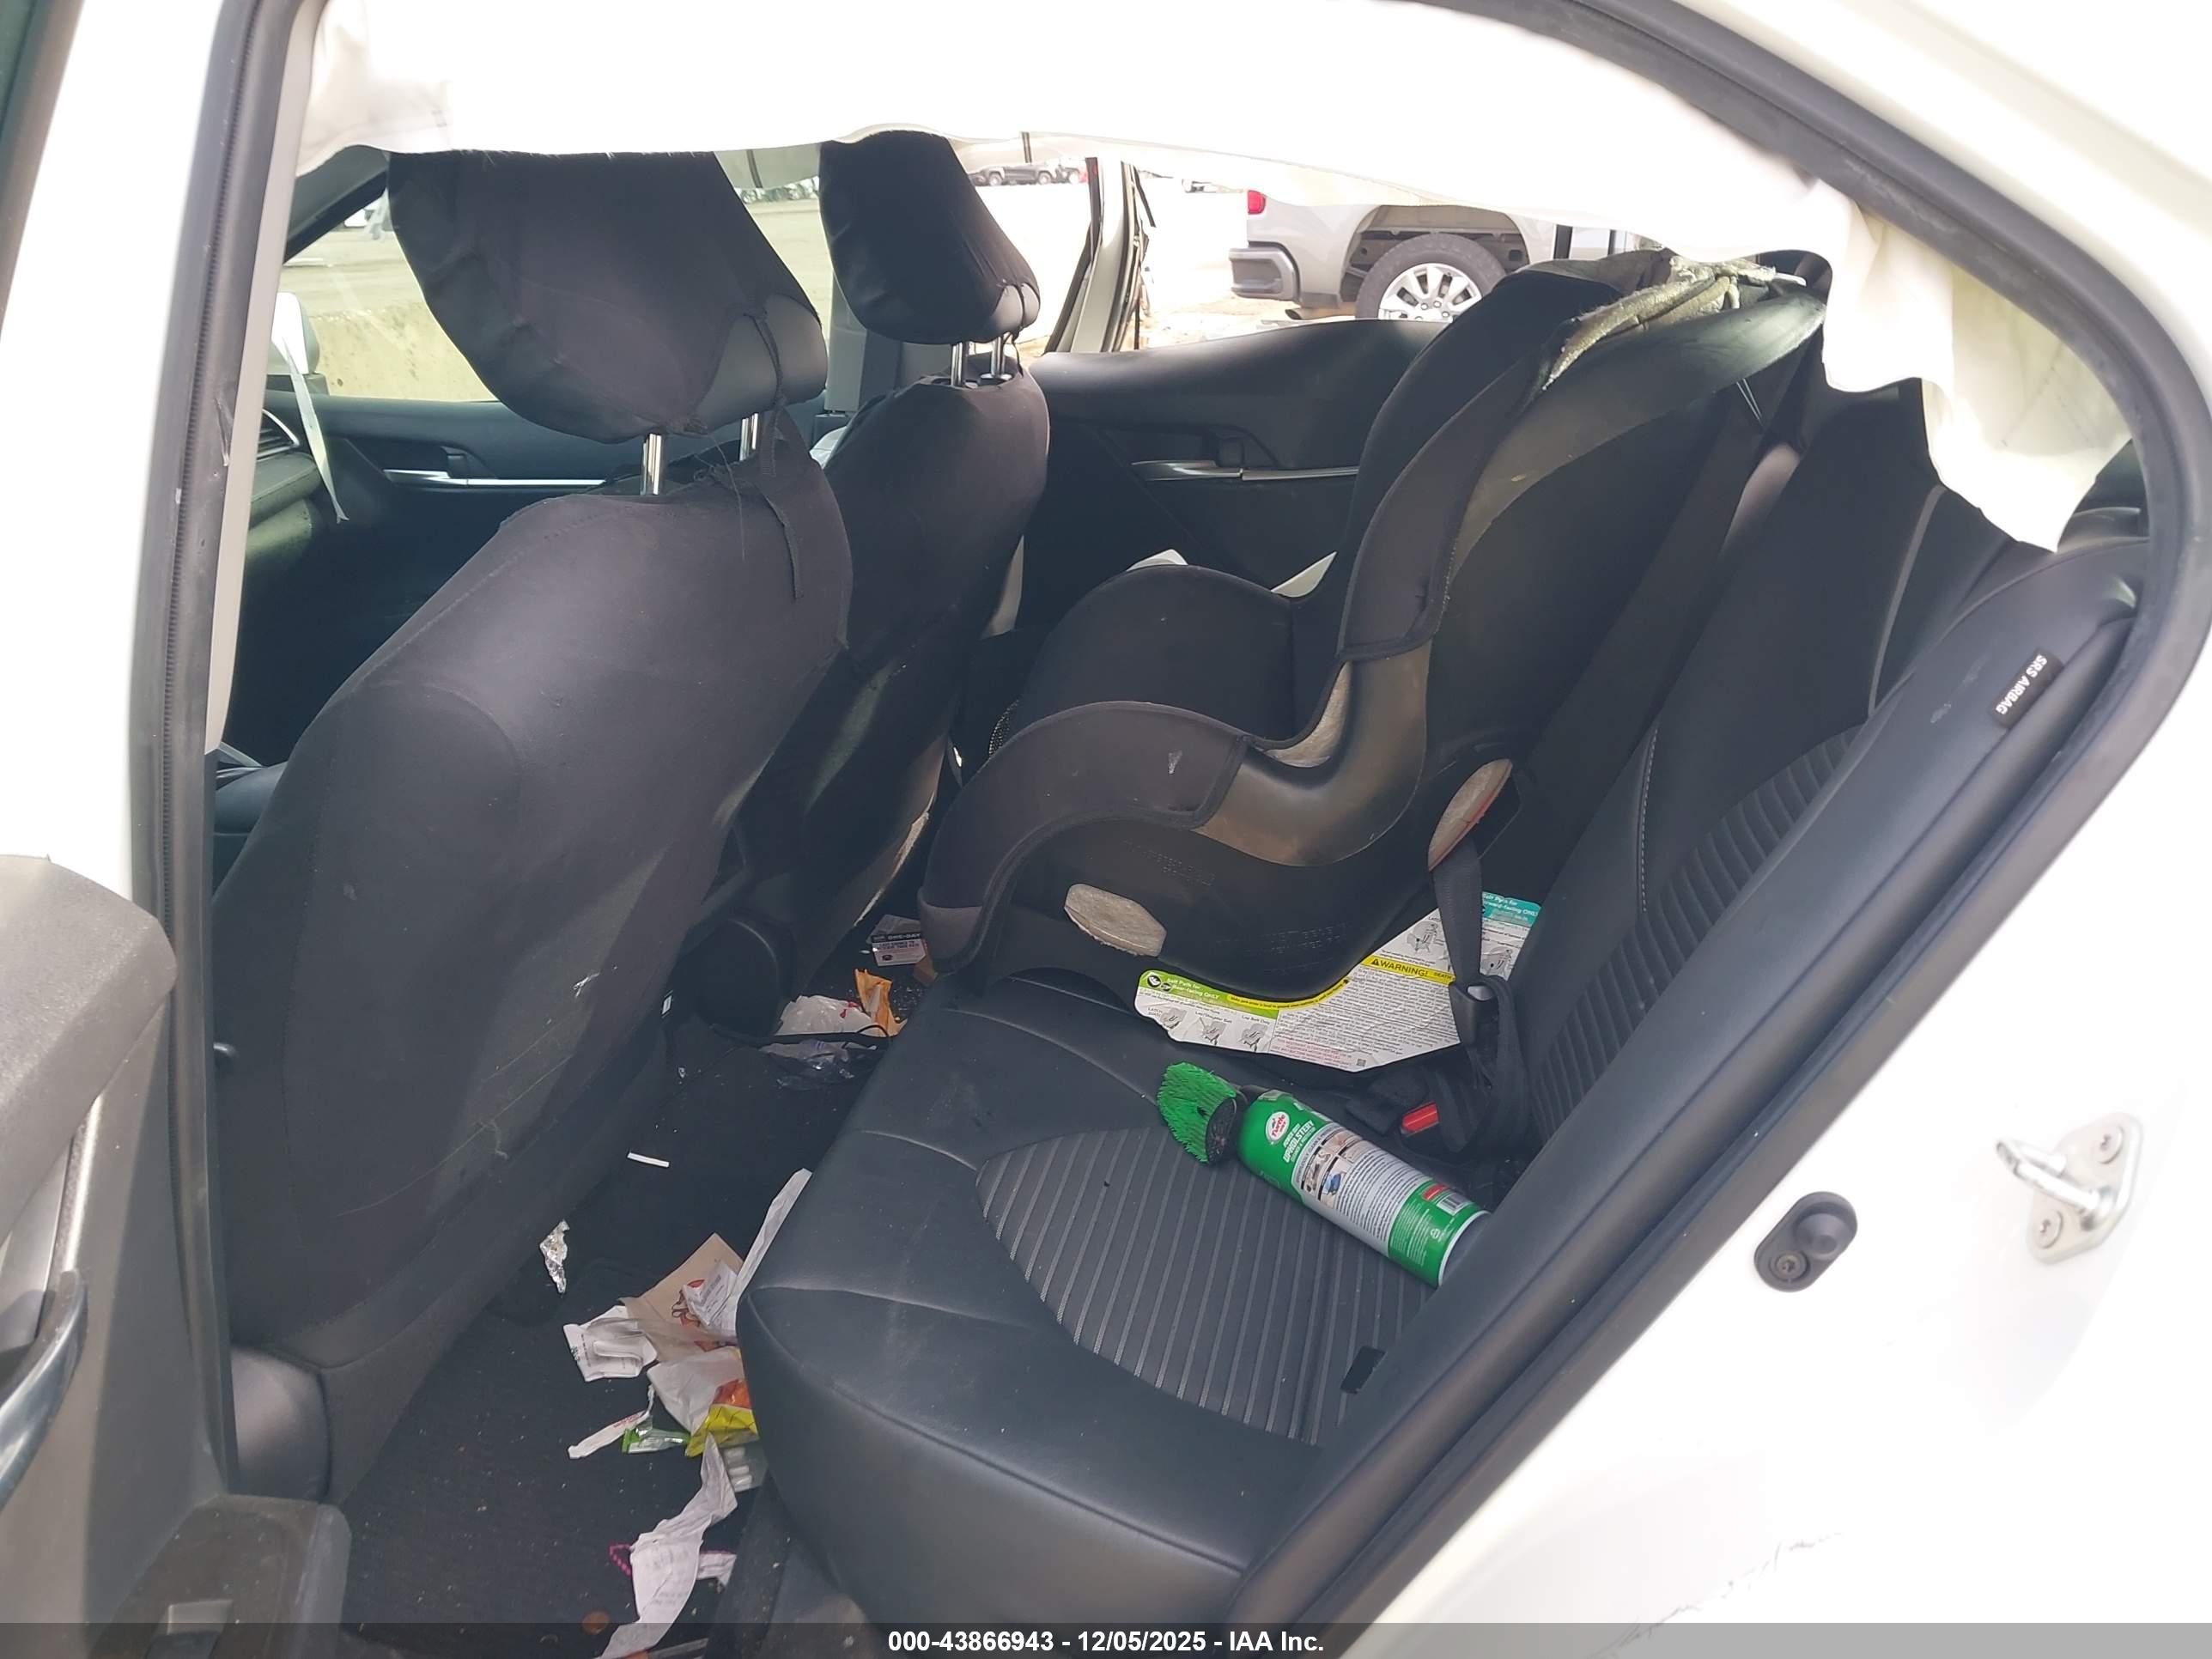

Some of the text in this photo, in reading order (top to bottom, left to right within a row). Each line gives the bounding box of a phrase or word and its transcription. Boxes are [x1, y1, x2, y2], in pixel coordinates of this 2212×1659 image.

[1995, 654, 2048, 715] SRS AIRBAG
[1381, 960, 1429, 977] WARNING!
[1272, 1114, 1286, 1138] Turtle
[1282, 1119, 1315, 1163] UPHOLSTERY
